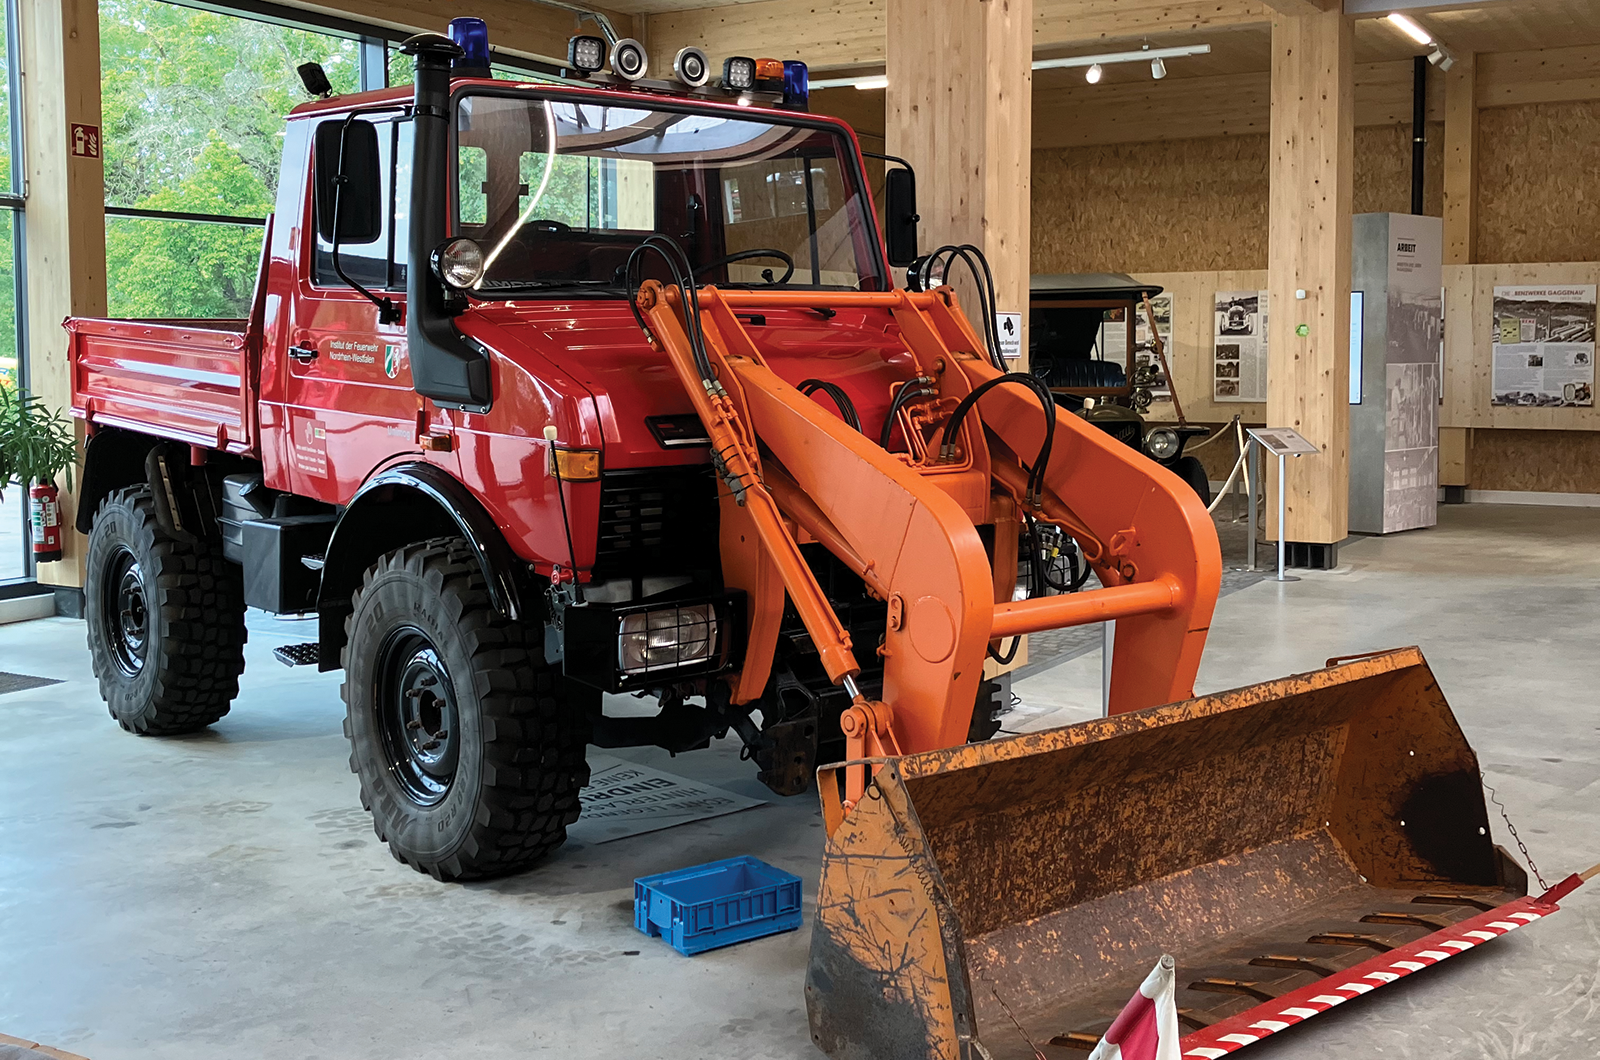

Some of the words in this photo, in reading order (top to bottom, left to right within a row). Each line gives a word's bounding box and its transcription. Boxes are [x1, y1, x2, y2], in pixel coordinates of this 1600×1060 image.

[1397, 242, 1416, 253] ARBEIT
[330, 340, 345, 349] Institut
[345, 342, 353, 350] der
[353, 342, 379, 352] Feuerwehr
[329, 351, 375, 364] Nordrhein-Westfalen
[388, 425, 410, 440] Unimog
[592, 769, 646, 787] KEINE
